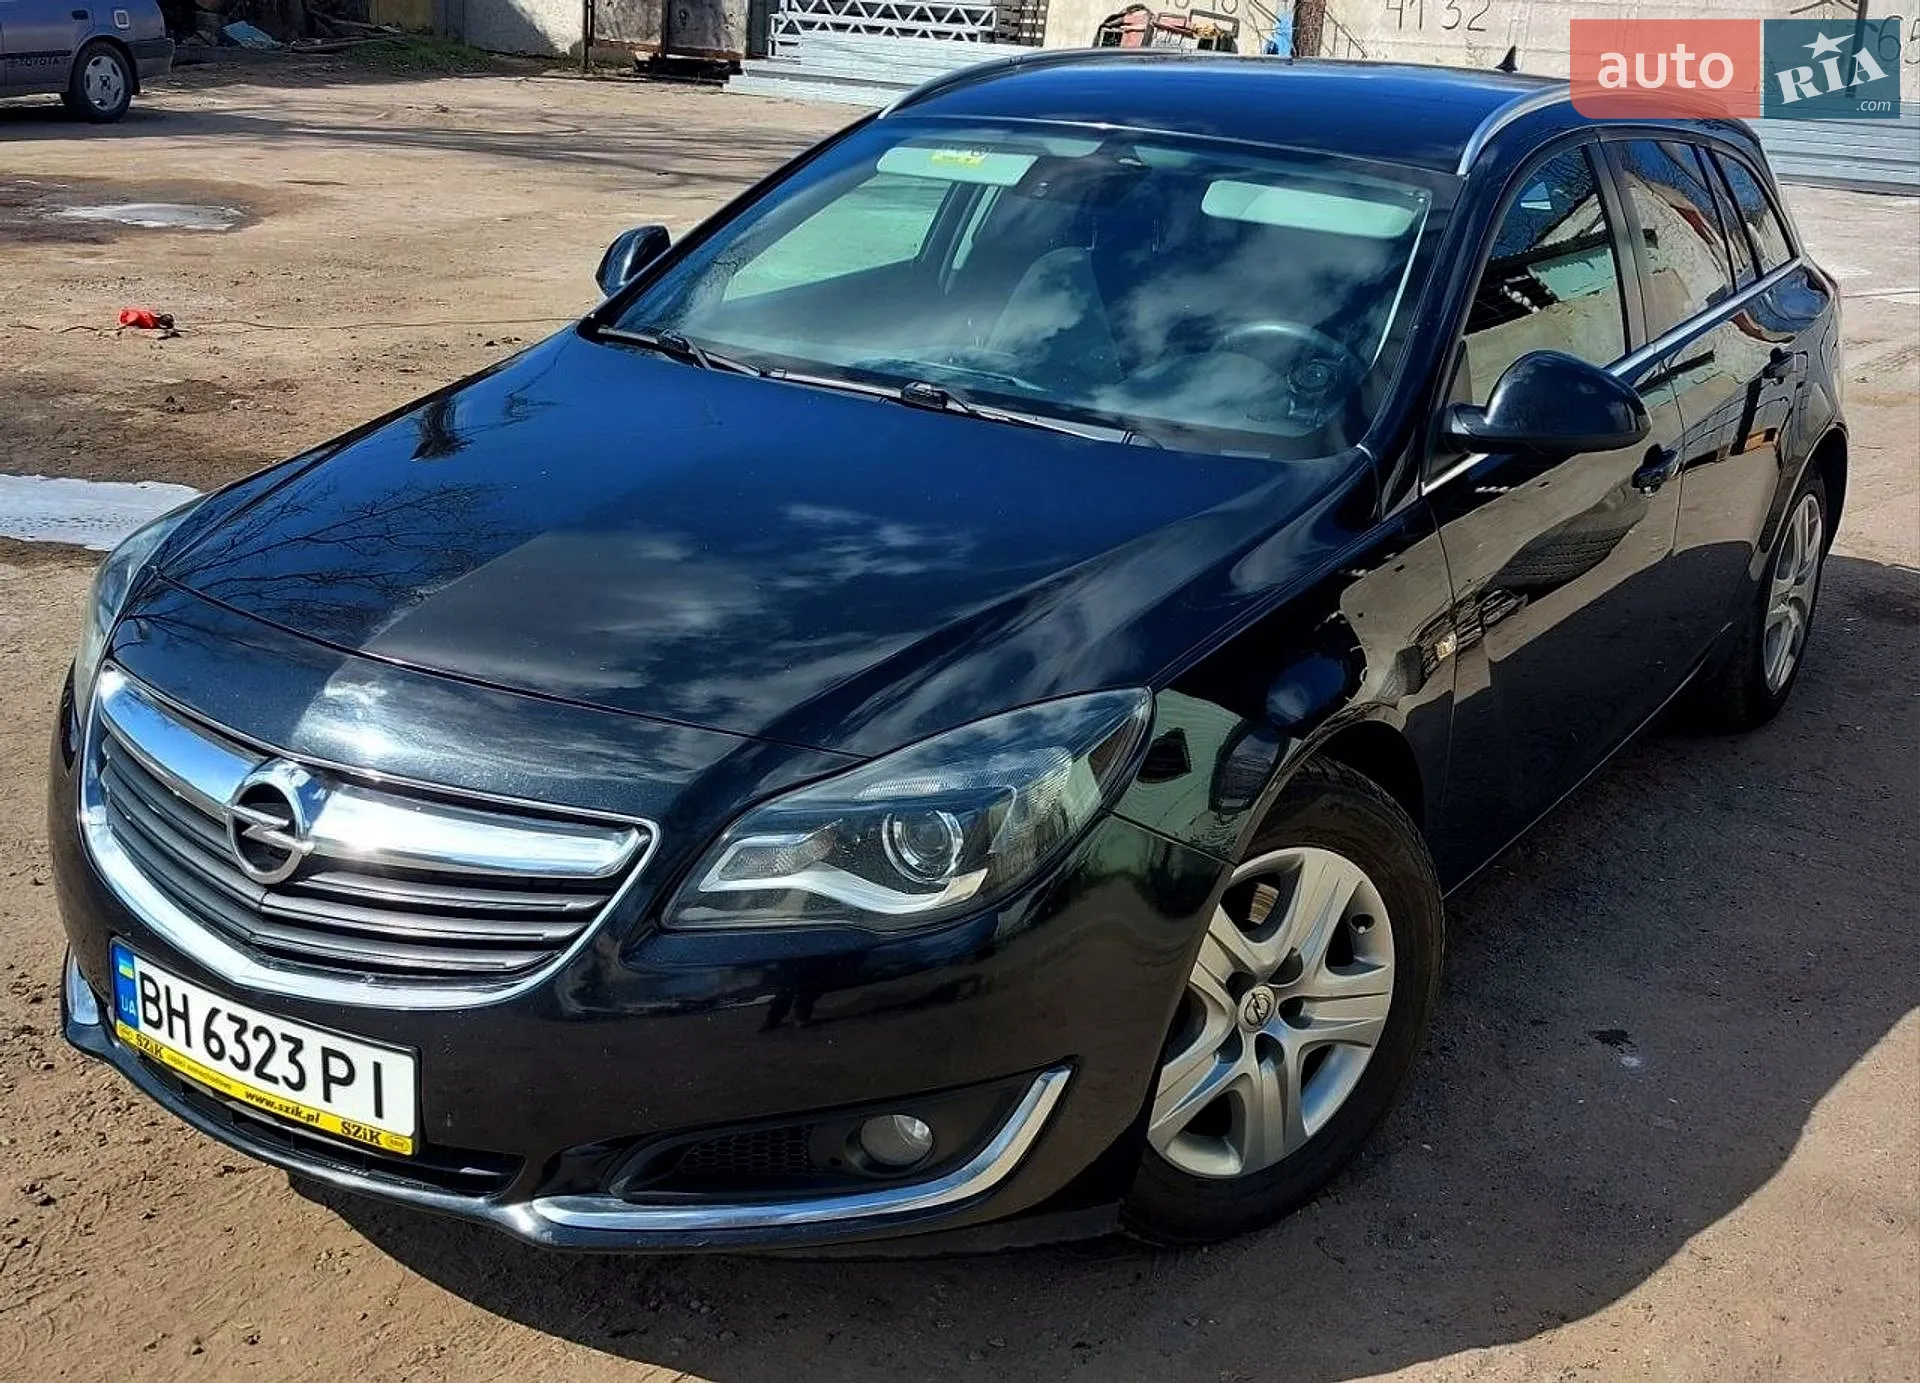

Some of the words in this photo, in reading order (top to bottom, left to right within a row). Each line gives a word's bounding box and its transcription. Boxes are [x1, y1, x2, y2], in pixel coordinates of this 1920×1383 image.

[121, 997, 136, 1015] UA
[140, 970, 192, 1048] BH
[203, 1006, 306, 1092] 6323
[321, 1045, 384, 1119] PI
[136, 1033, 164, 1058] SZiK
[245, 1090, 320, 1124] www.szik.pl
[340, 1121, 382, 1145] SZiK
